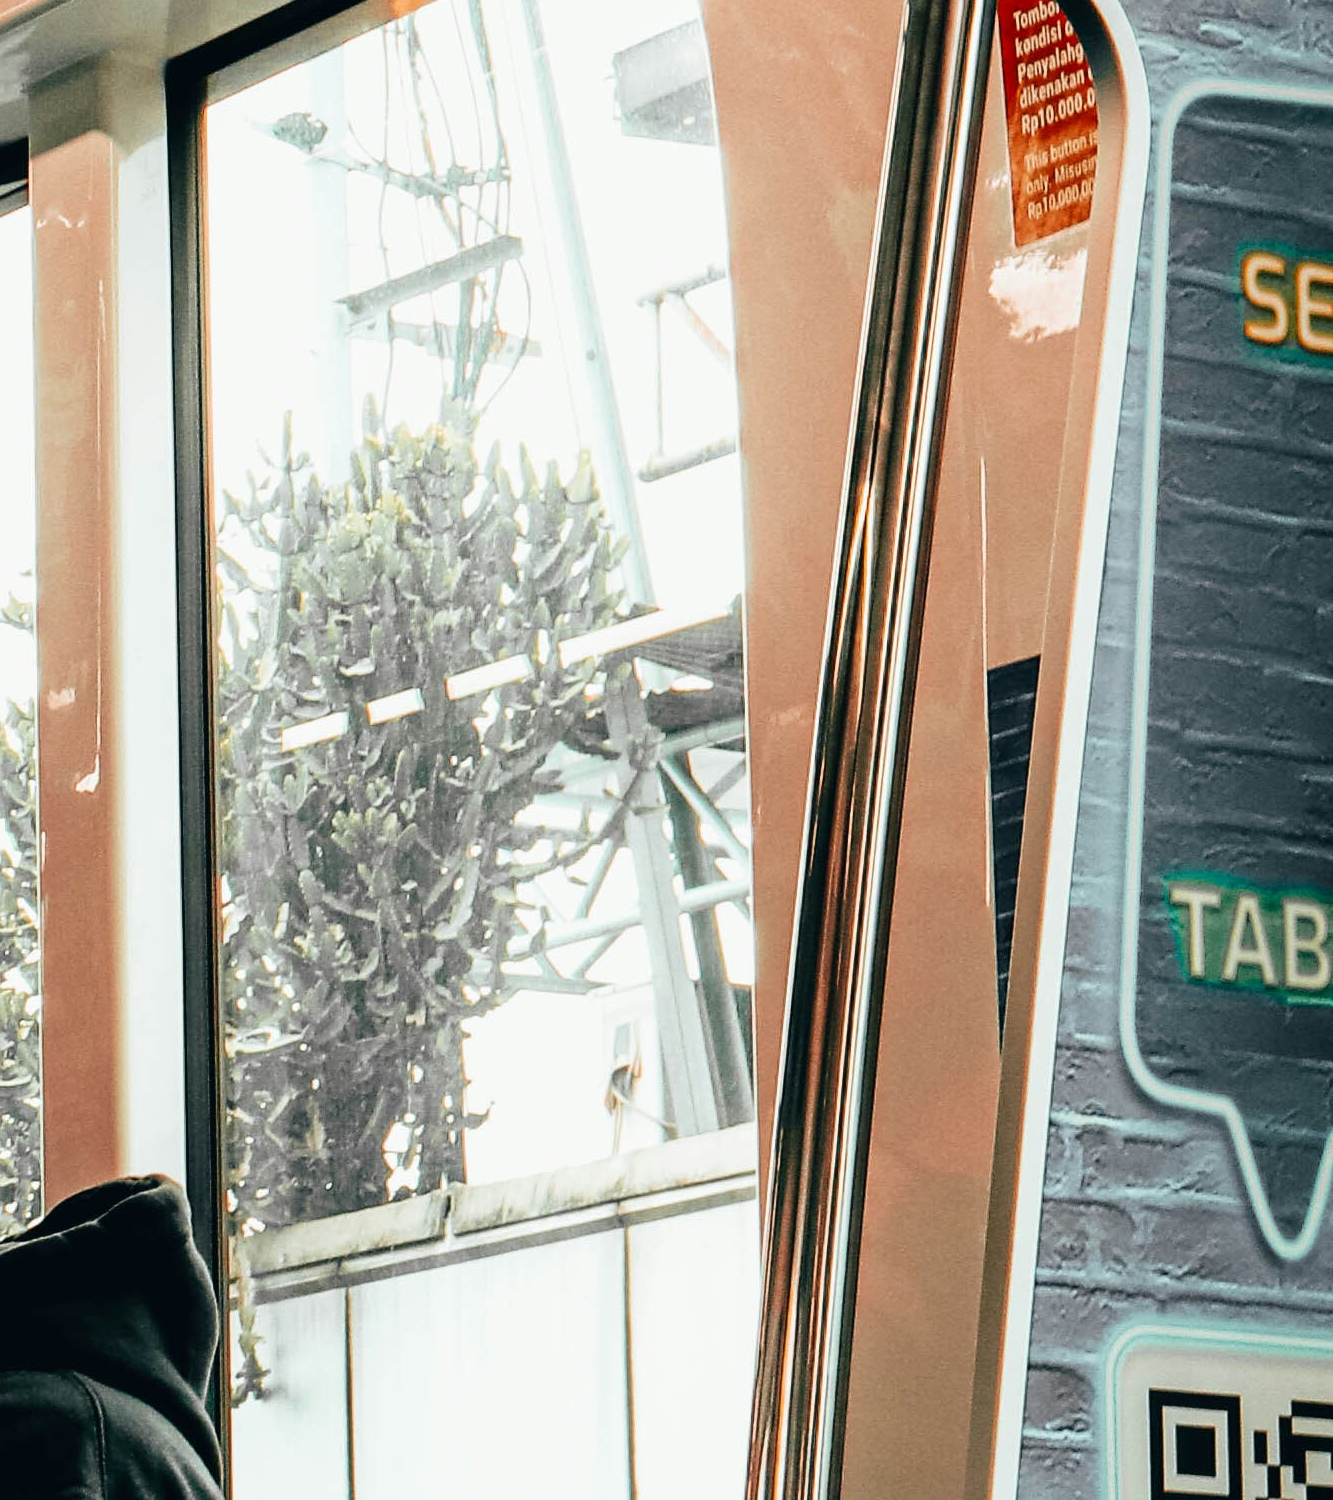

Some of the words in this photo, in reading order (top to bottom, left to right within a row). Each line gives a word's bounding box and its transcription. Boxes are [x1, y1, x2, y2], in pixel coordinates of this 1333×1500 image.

[1014, 25, 1062, 59] kondisi
[1018, 67, 1085, 110] dikenakan
[1023, 150, 1050, 174] This
[1049, 135, 1089, 165] button
